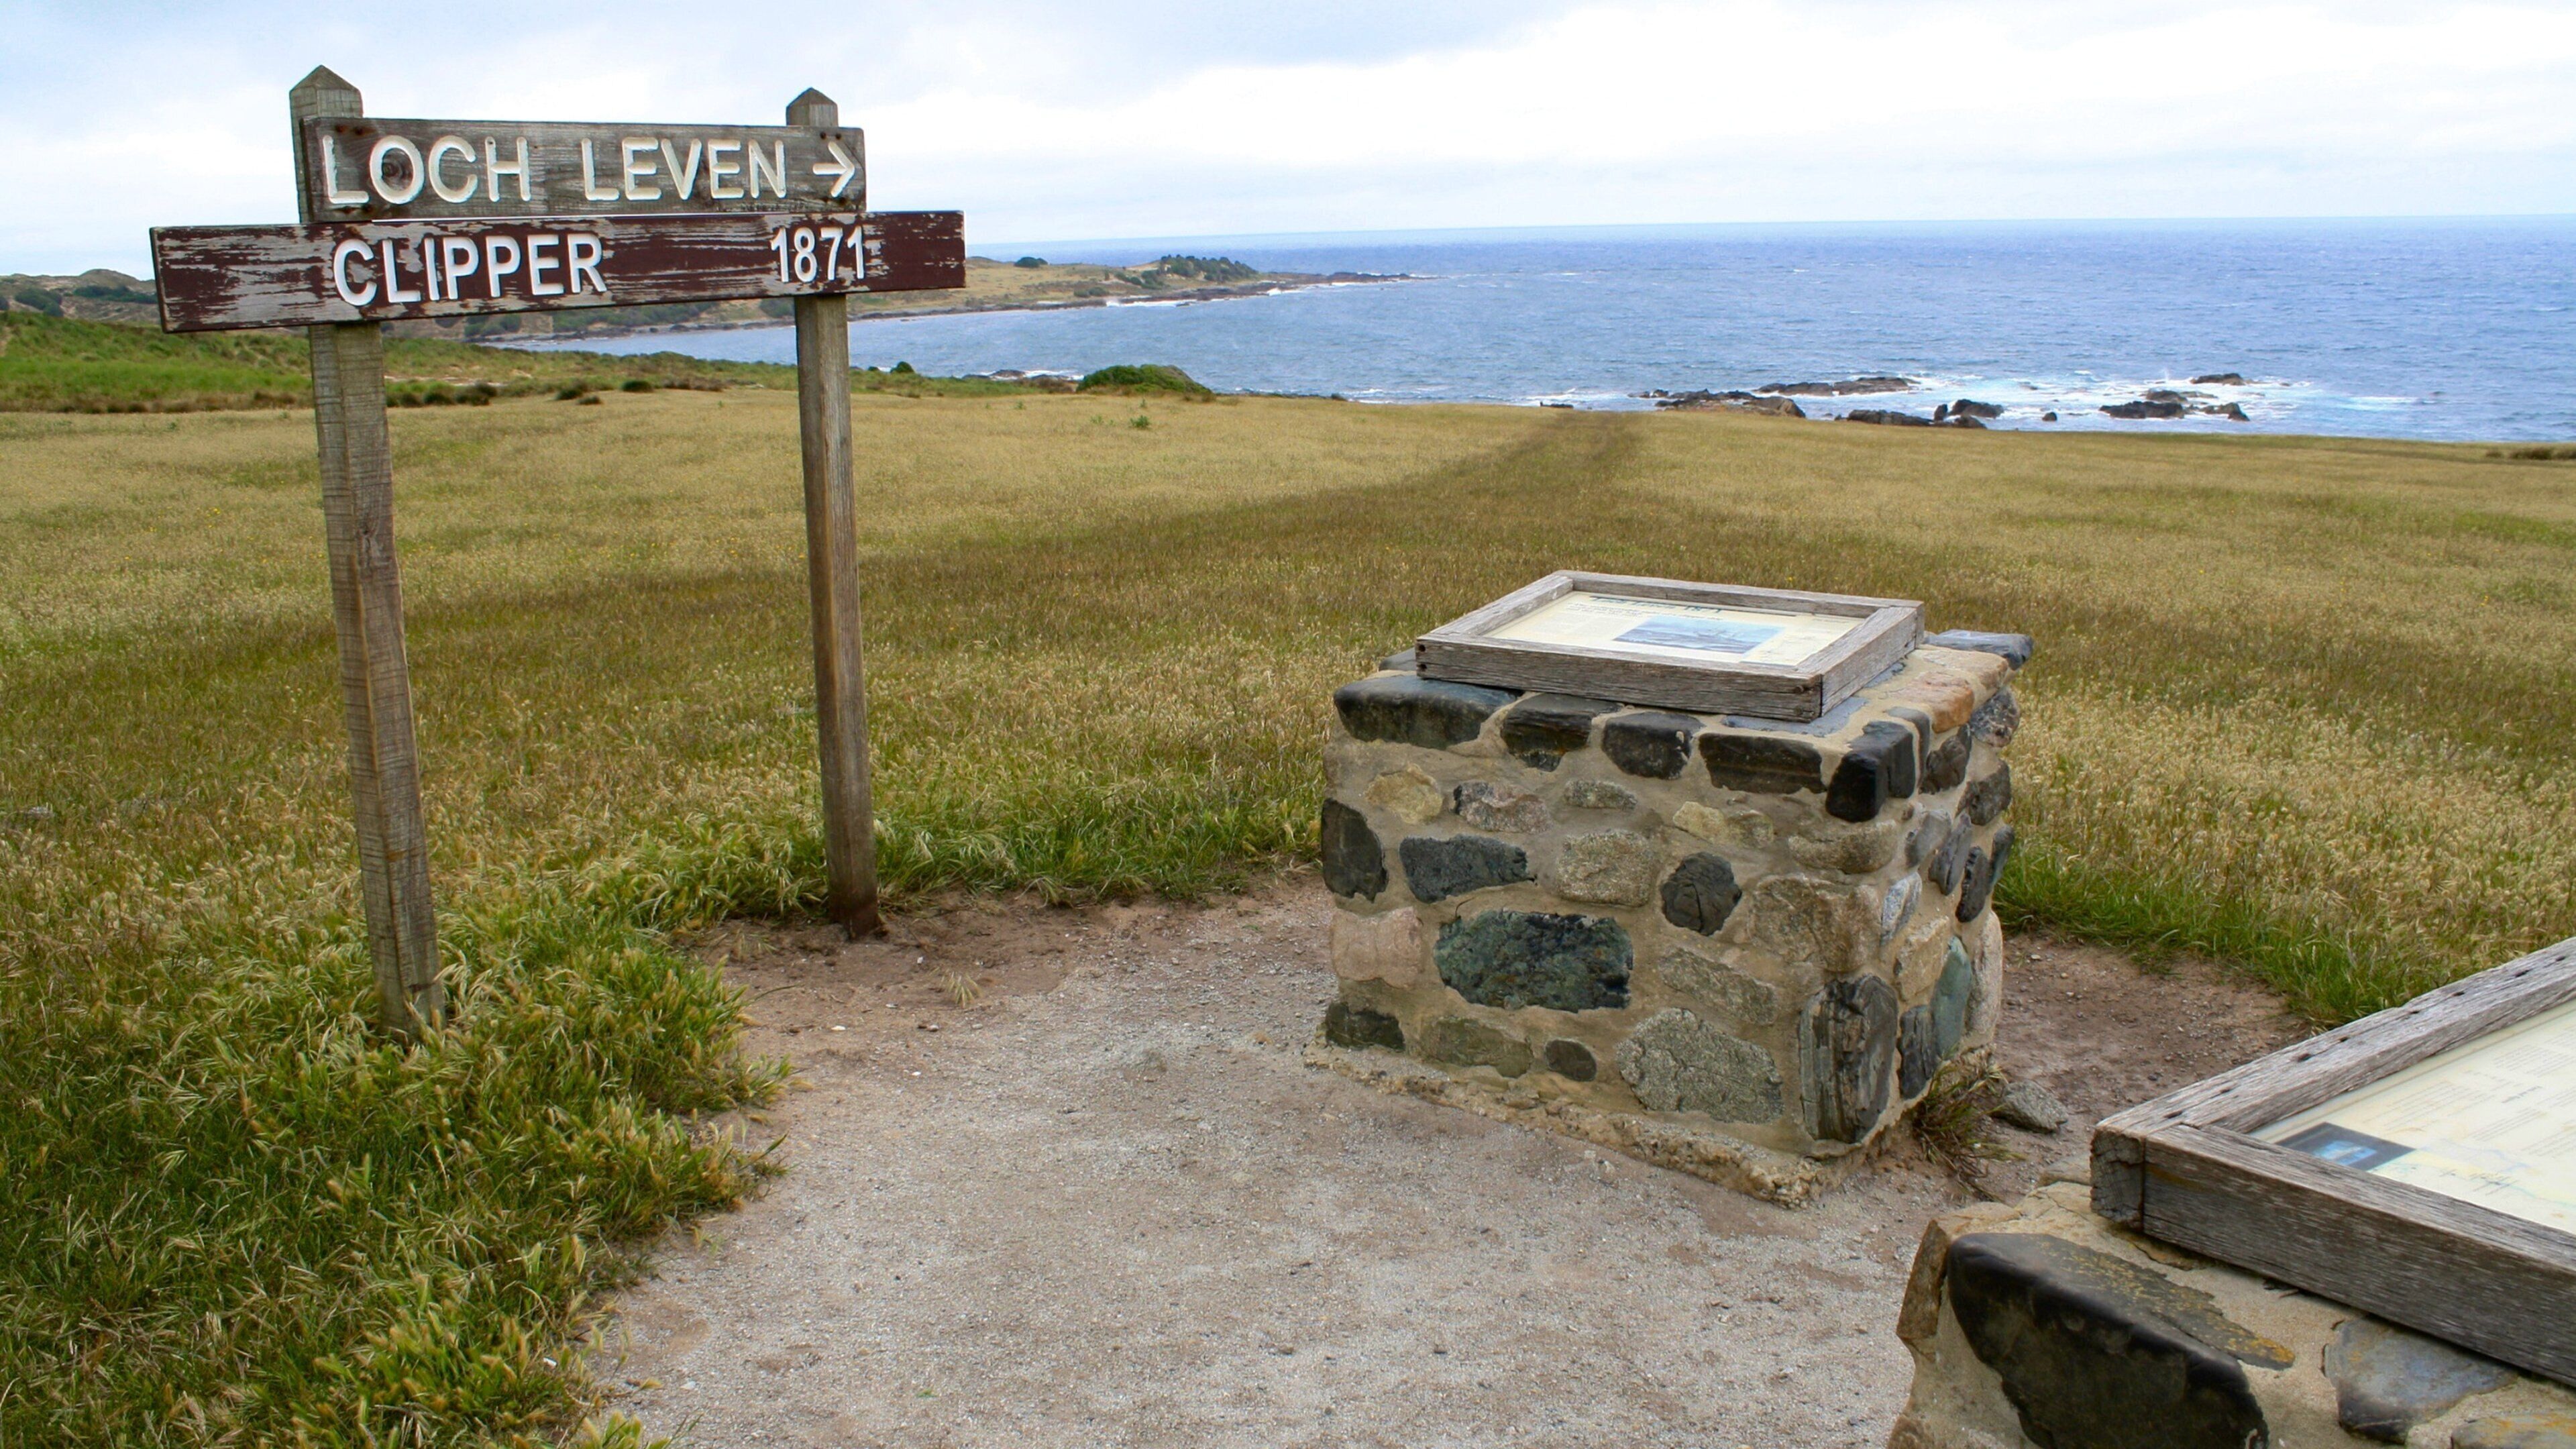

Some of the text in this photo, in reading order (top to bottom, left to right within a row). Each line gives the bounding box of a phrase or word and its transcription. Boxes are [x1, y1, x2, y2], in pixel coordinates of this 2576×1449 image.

[322, 135, 787, 205] LOCH LEVEN
[333, 226, 865, 306] CLIPPER 1871
